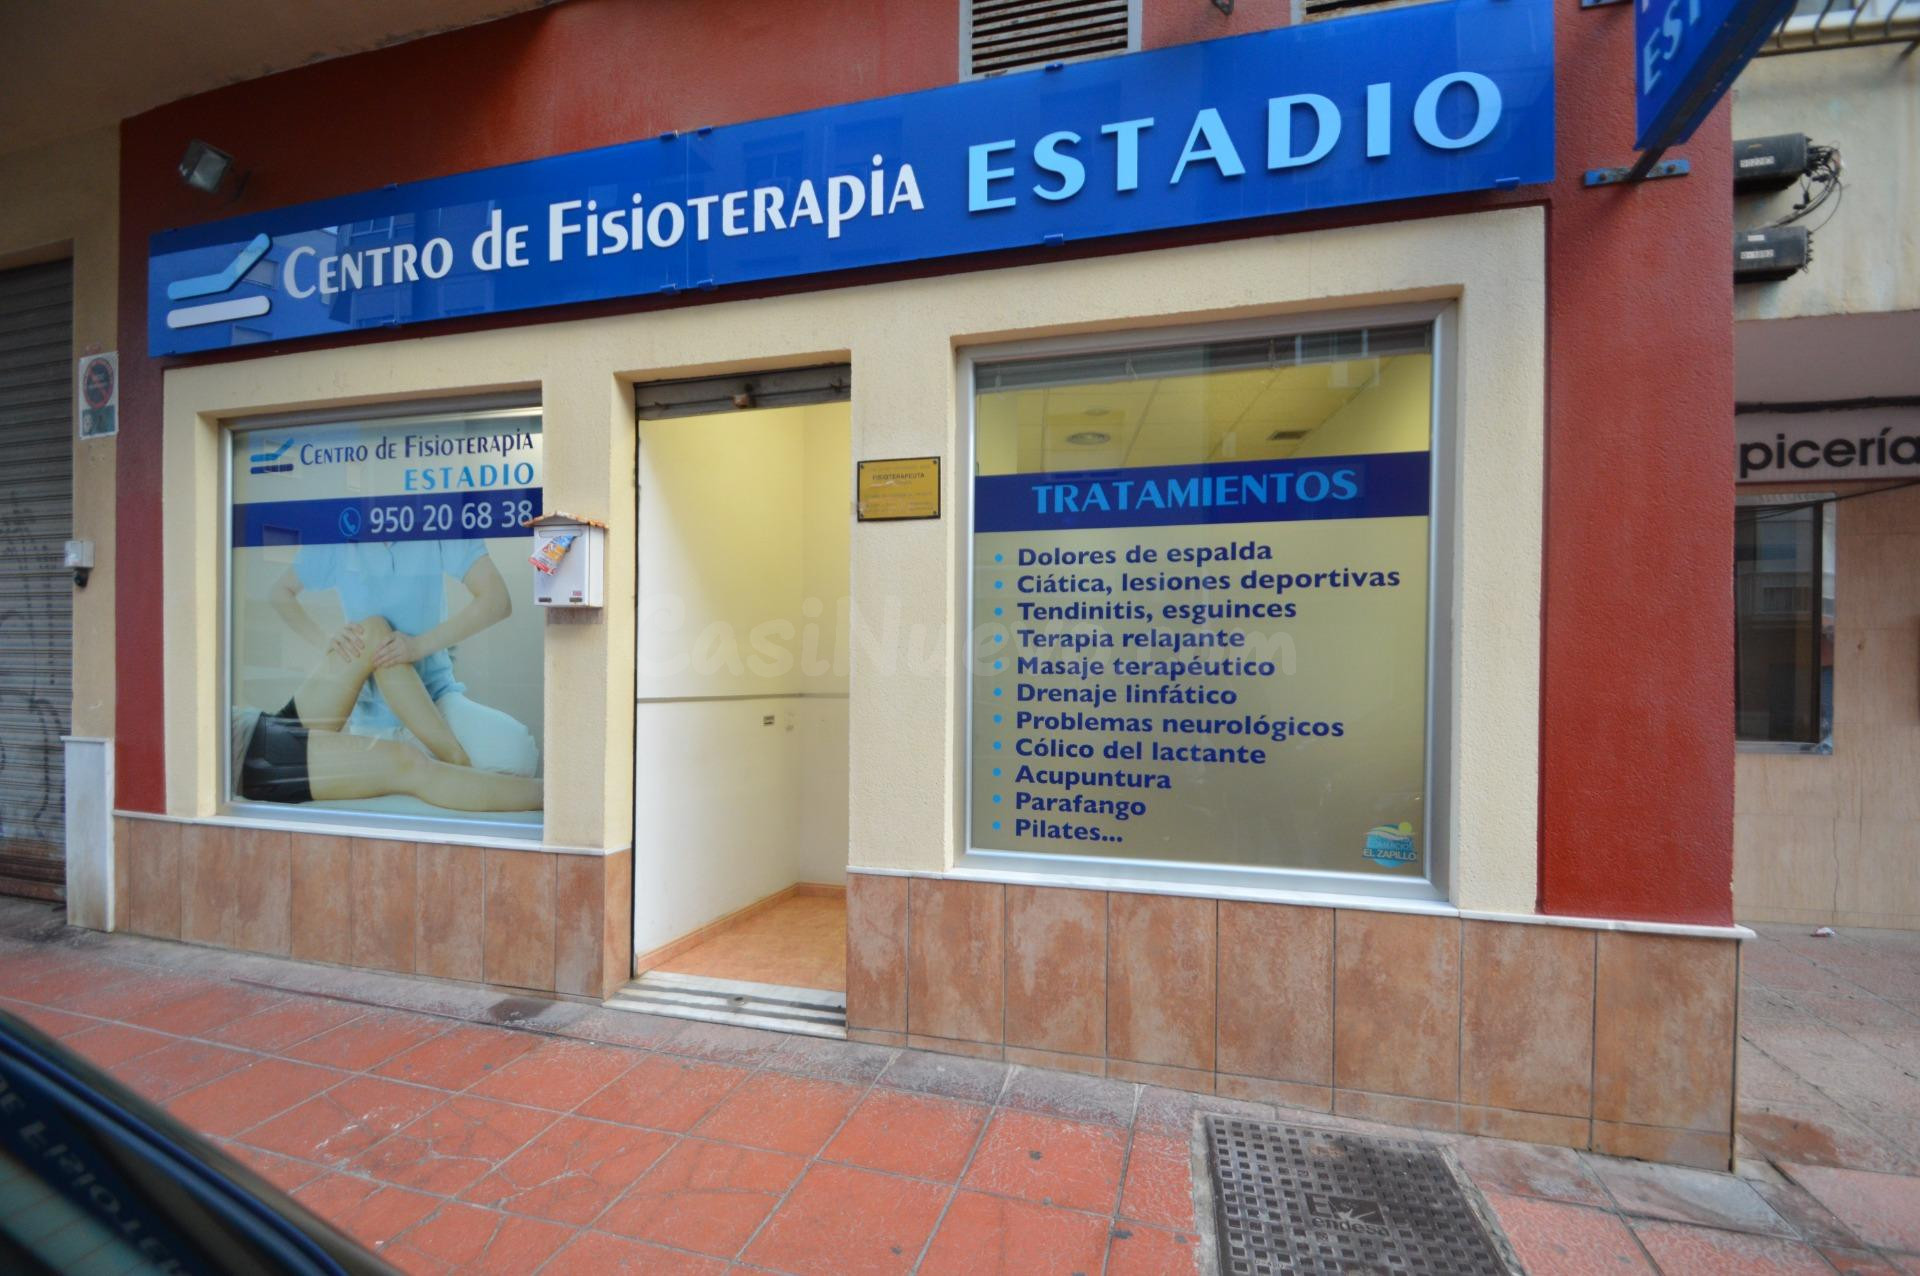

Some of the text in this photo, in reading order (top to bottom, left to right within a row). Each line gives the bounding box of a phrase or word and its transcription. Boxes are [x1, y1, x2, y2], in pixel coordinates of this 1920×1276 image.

[968, 71, 1502, 212] ESTADIO
[1740, 427, 1920, 479] picería
[404, 462, 534, 491] ESTADIO
[1031, 469, 1358, 514] TRATAMIENTOS
[370, 500, 533, 533] 950 20 68 38
[1018, 542, 1273, 568] Dolores de espalda
[1017, 568, 1401, 596] Ciática, lesiones deportivas
[1017, 600, 1297, 625] Tendinitis, esguinces
[1017, 628, 1245, 654] Terapia relajante
[1017, 655, 1276, 682] Masaje terapéutico
[1017, 683, 1238, 709] Drenaje linfático
[1016, 711, 1344, 742] Problemas neurológicos
[1015, 736, 1266, 766] Cólico del lactante
[1015, 764, 1172, 790] Acupuntura
[1015, 791, 1147, 820] Parafango
[1015, 818, 1123, 844] Pilates...
[1311, 1217, 1390, 1237] endesa
